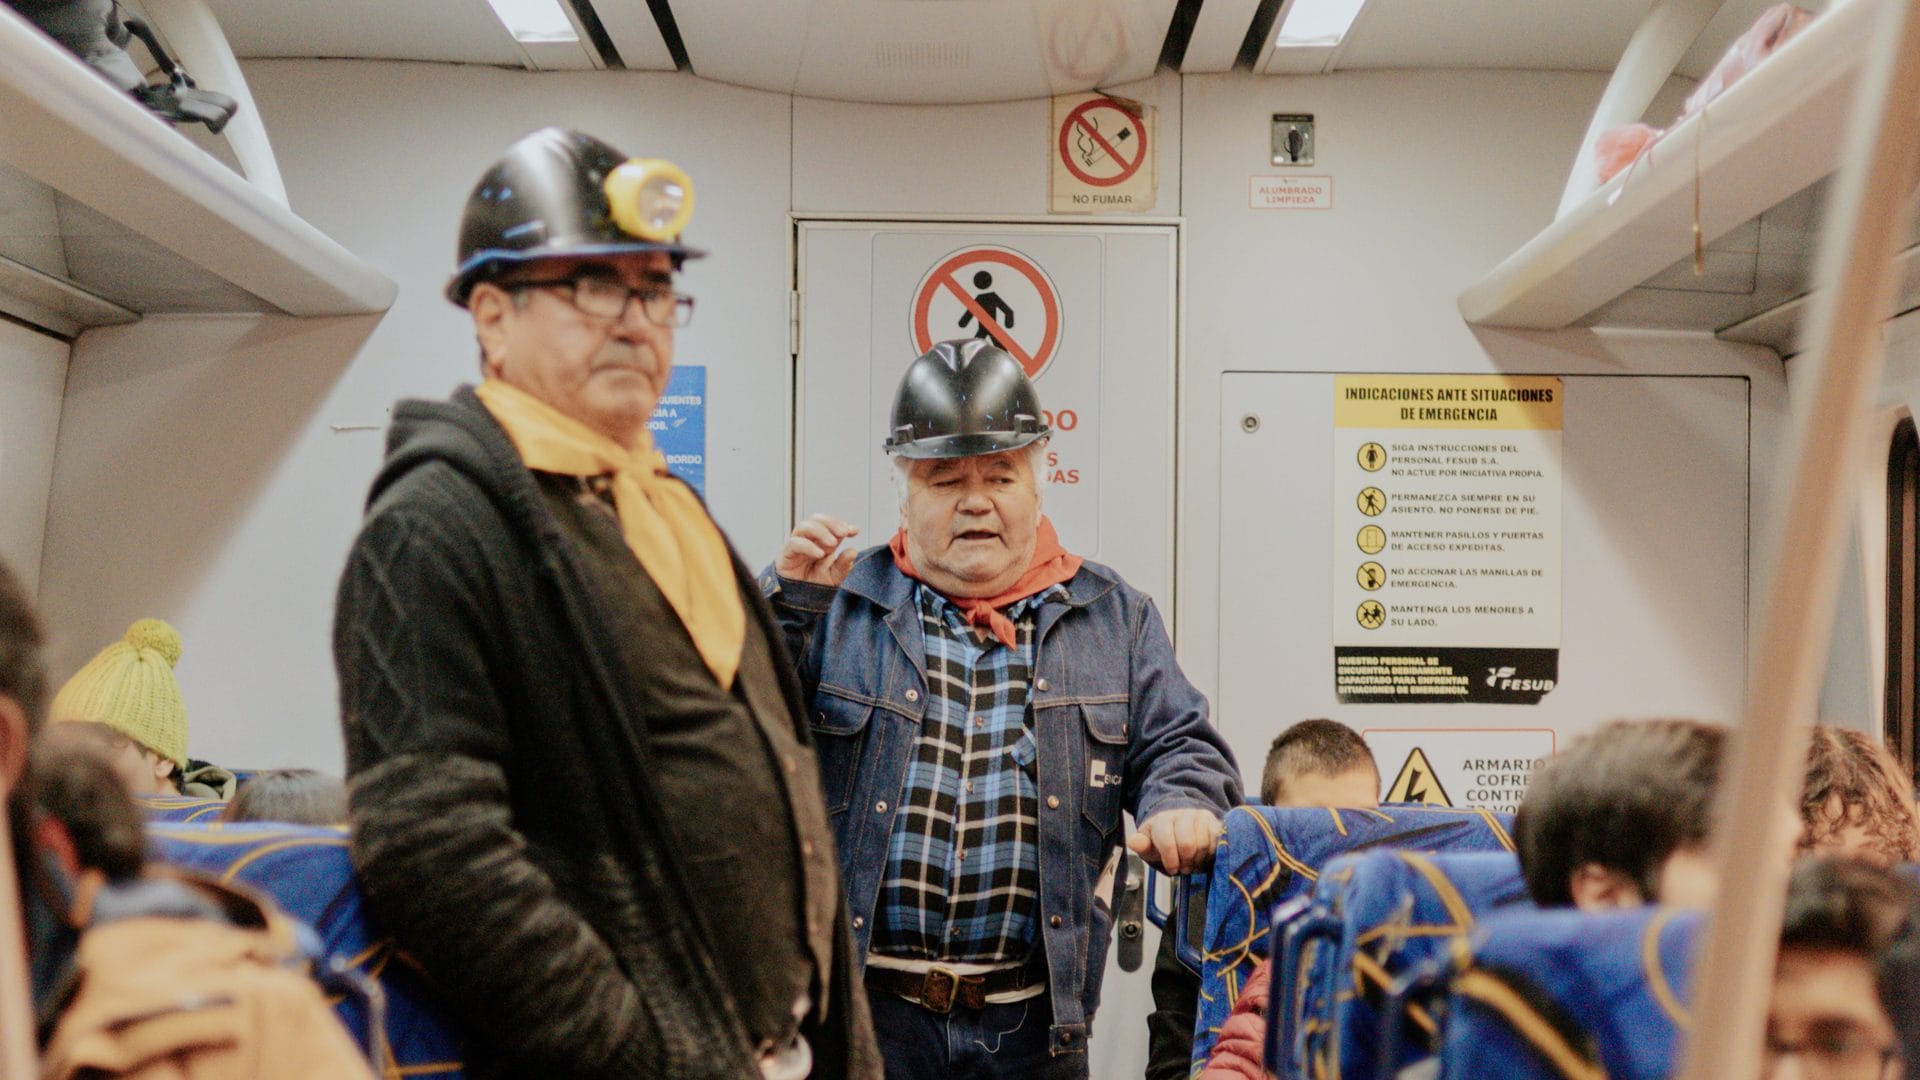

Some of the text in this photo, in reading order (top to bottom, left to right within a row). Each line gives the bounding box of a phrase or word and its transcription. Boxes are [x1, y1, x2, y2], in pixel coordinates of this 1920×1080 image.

[1259, 187, 1322, 195] ALUMBRADO
[1073, 195, 1132, 204] NO FUMAR
[1345, 387, 1553, 402] INDICACIONES ANTE SITUACIONES
[1400, 408, 1498, 421] DE EMERGENCIA
[1392, 444, 1518, 453] SIGA INSTRUCCIONES DEL
[666, 455, 702, 464] BORDO
[1392, 456, 1499, 465] PERSONAL FESUB S.A.
[1392, 469, 1544, 478] NO ACTUE POR INICIATIVA PROPIA.
[1392, 494, 1458, 502] PERMANEZCA
[1461, 494, 1501, 502] SIEMPRE
[1523, 495, 1536, 503] SU
[1439, 506, 1454, 514] NO
[1505, 507, 1518, 515] DE
[1520, 507, 1538, 515] PIE.
[1446, 531, 1490, 539] PASILLOS
[1492, 531, 1499, 539] Y
[1501, 532, 1544, 540] PUERTAS
[1391, 543, 1505, 552] DE ACCESO EXPEDITAS.
[1391, 568, 1544, 577] NO ACCIONAR LAS MANILLAS DE
[1391, 580, 1458, 588] EMERGENCIA.
[1391, 605, 1534, 615] MANTENGA LOS MENORES A
[1391, 618, 1438, 627] SU LADO.
[1337, 656, 1439, 666] NUESTRO PERSONAL SE
[1337, 666, 1453, 675] ENCUENTRA DEBIDAMENTE
[1338, 676, 1469, 685] CAPACITADO PARA ENFRENTAR
[1501, 679, 1555, 691] FESUB
[1338, 685, 1396, 694] SITUACIONES
[1396, 685, 1409, 694] DE
[1463, 759, 1545, 771] ARMARIO
[1466, 790, 1524, 802] CONTR
